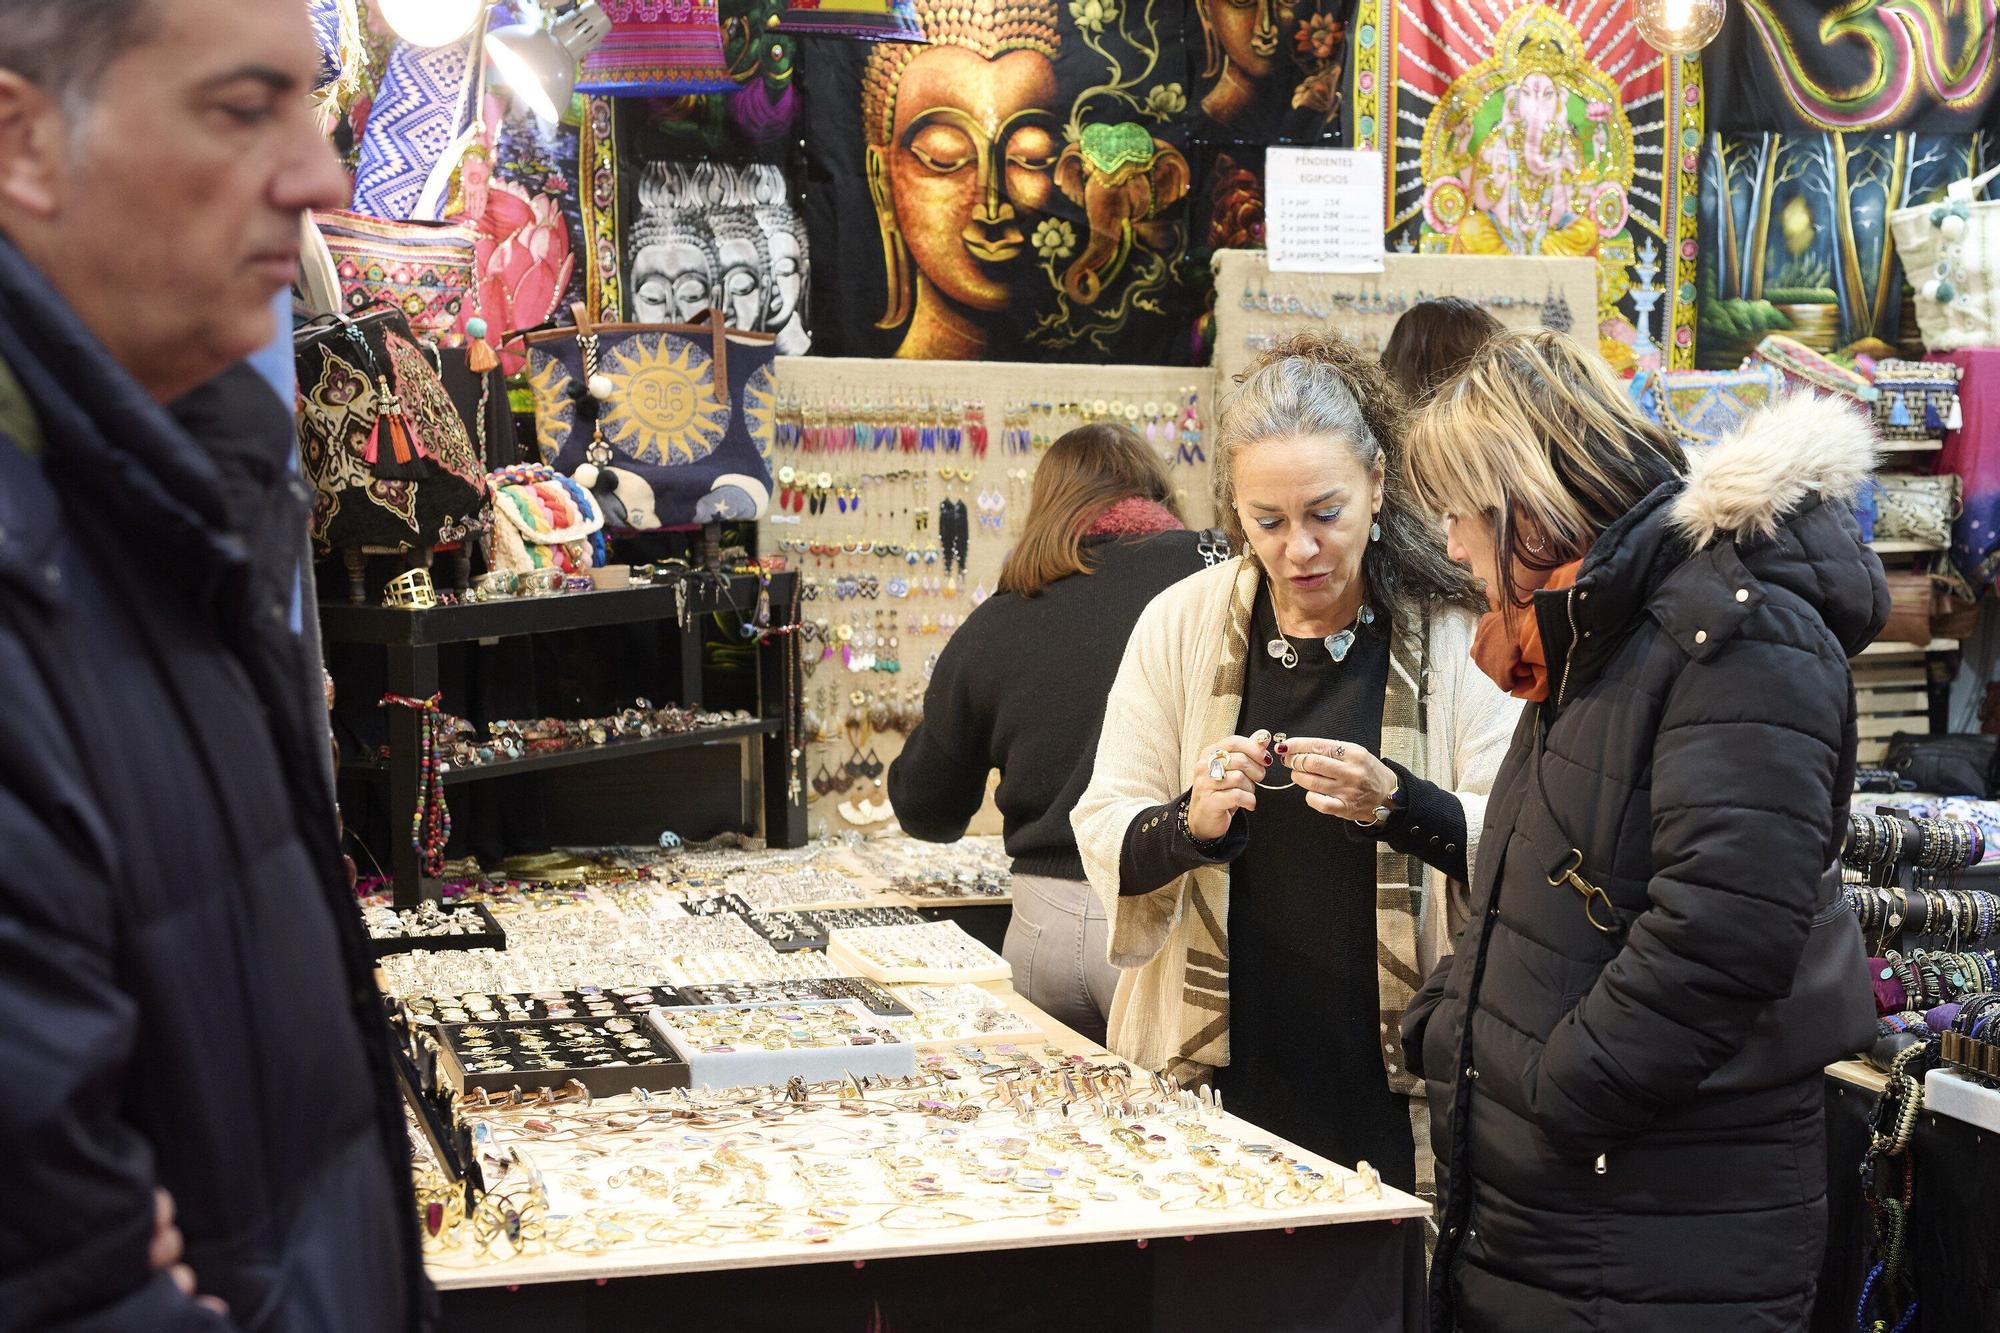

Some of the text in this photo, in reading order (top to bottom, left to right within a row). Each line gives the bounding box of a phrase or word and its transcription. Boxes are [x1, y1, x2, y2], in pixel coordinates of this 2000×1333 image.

[1295, 156, 1353, 167] PENDIENTES
[1300, 174, 1348, 184] EGIPCIOS
[1296, 199, 1310, 207] par
[1296, 225, 1320, 233] pares
[1296, 251, 1320, 259] pares
